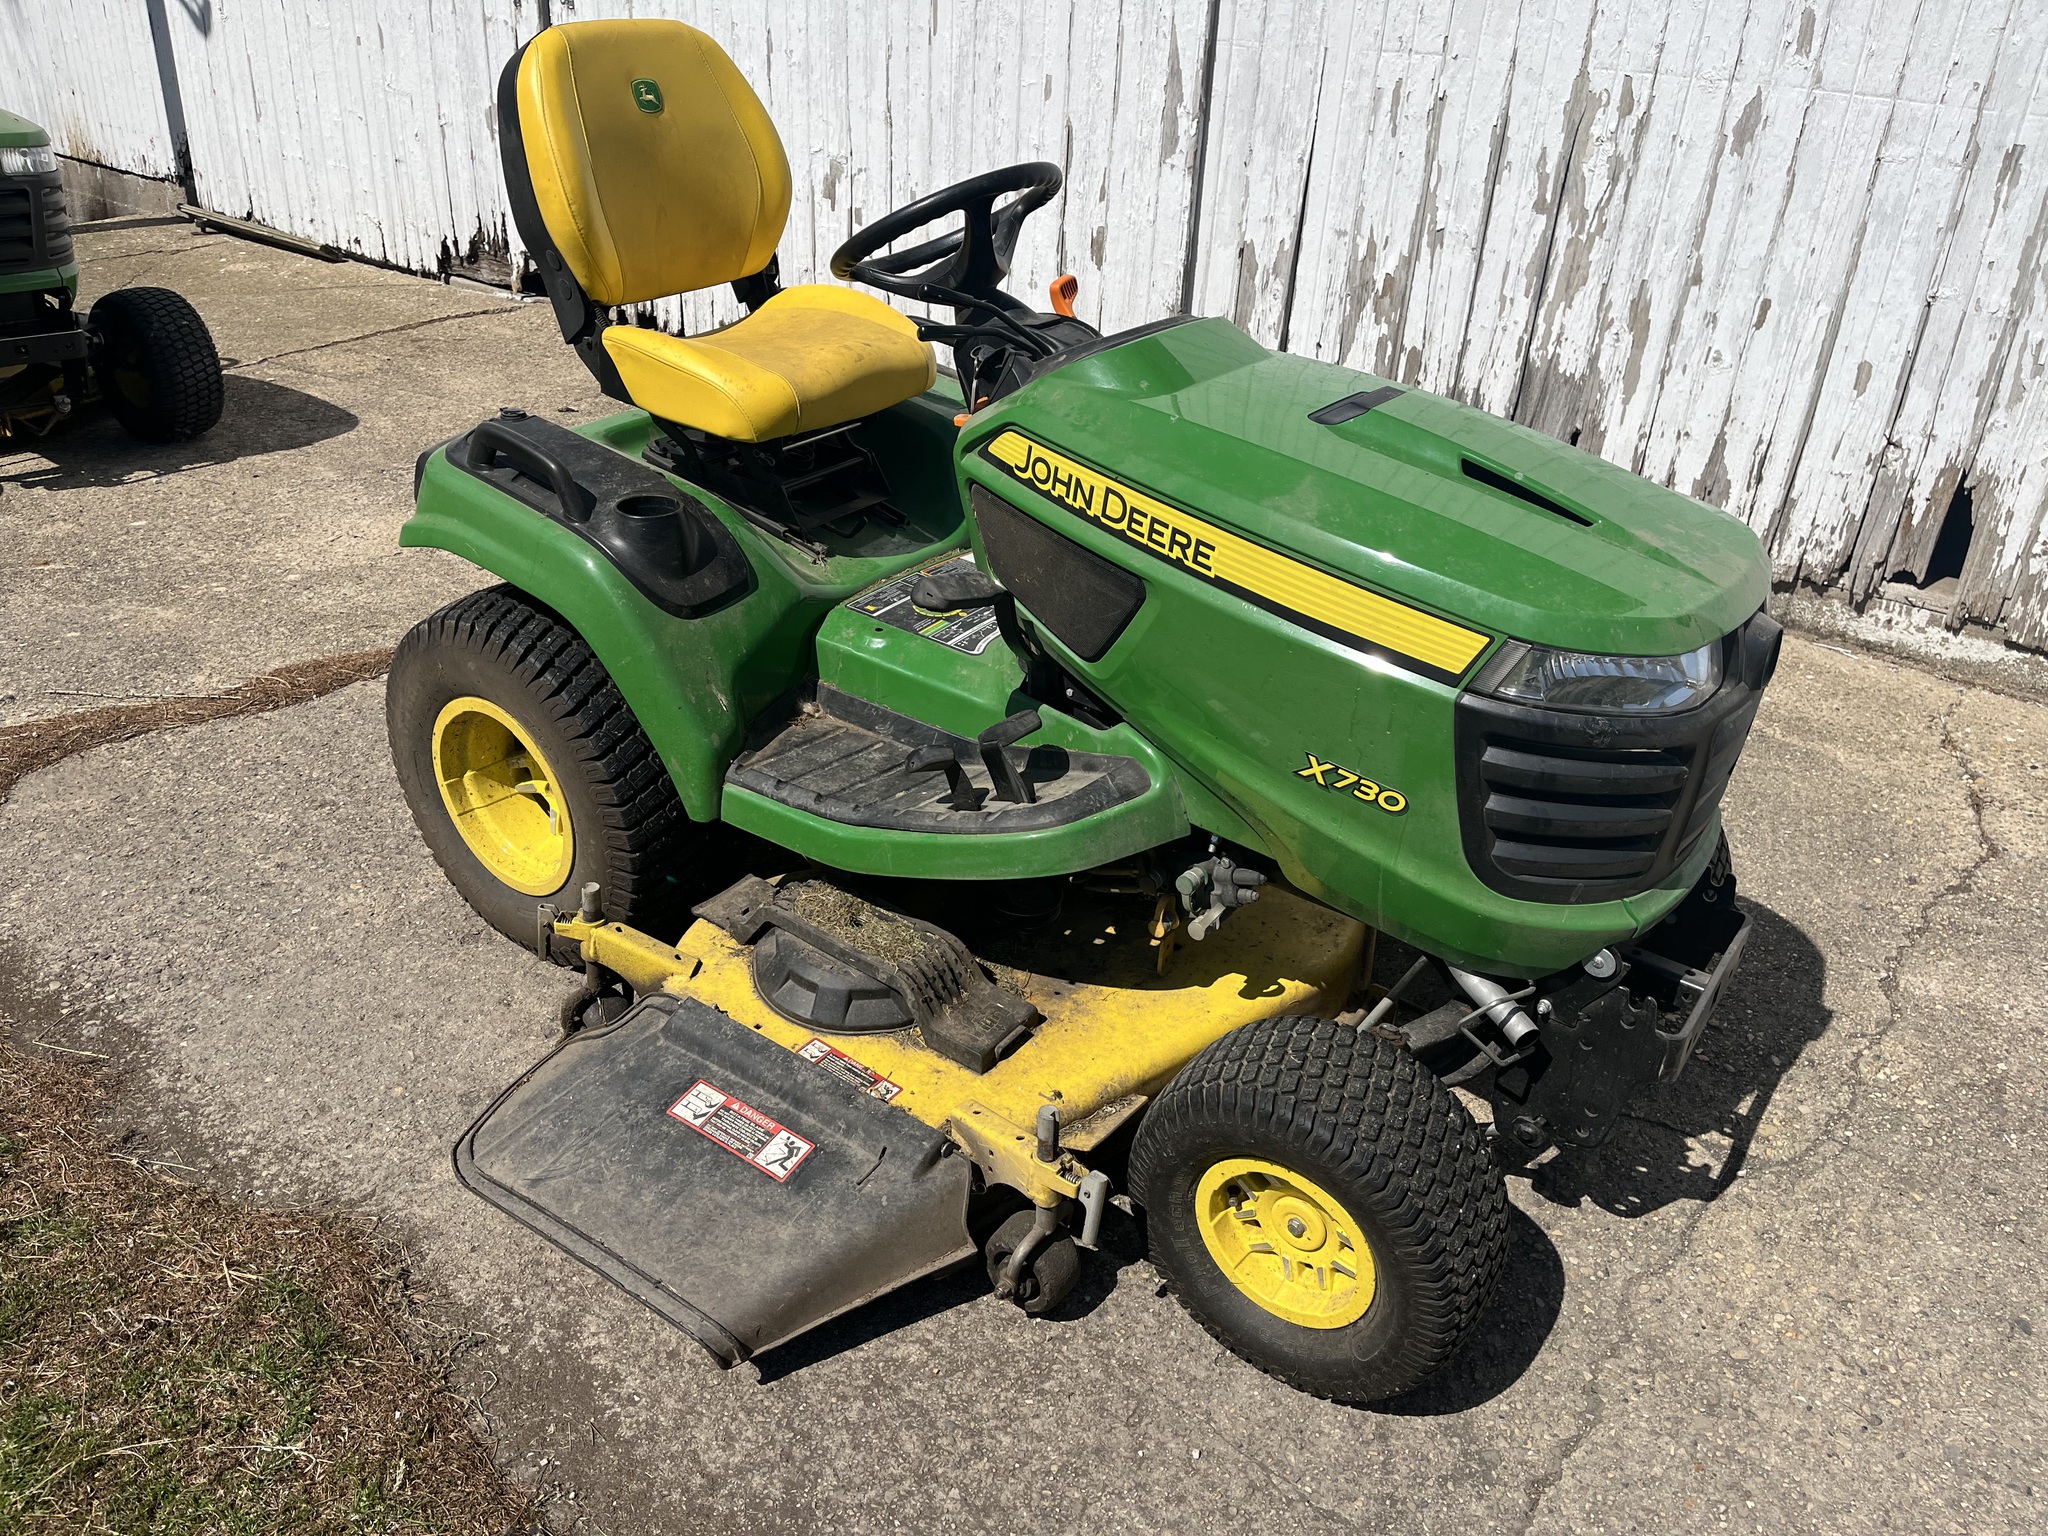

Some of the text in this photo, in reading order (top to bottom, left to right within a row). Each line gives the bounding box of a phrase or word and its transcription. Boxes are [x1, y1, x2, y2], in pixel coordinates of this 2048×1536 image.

[1014, 444, 1217, 576] JOHN DEERE
[1293, 751, 1408, 814] X730
[739, 1106, 776, 1130] DANGER
